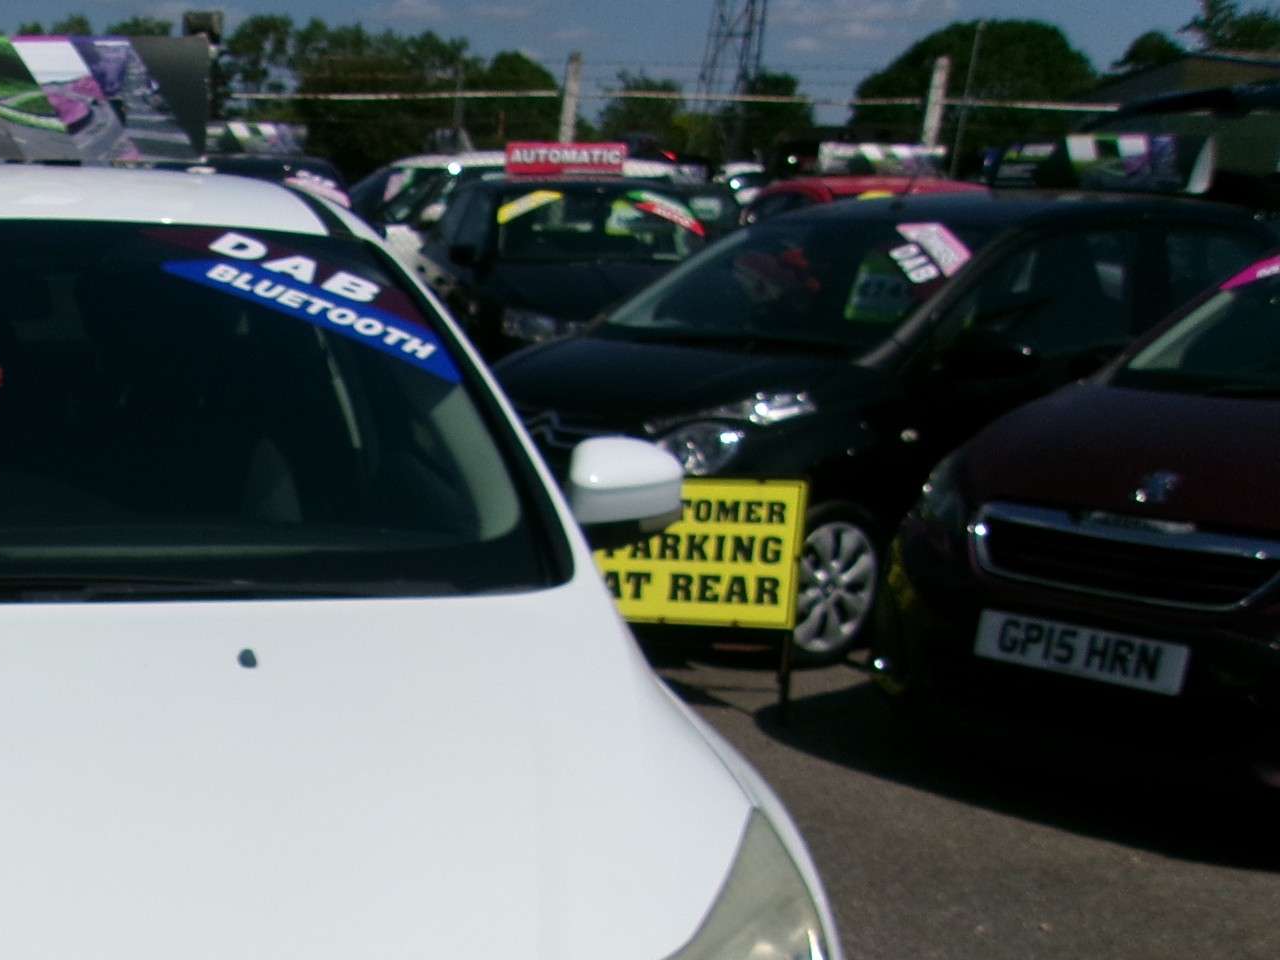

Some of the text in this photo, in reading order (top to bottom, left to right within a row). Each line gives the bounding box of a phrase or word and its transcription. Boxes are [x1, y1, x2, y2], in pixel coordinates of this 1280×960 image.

[510, 148, 621, 165] AUTOMATIC
[208, 231, 380, 302] DAB
[206, 263, 436, 361] BLUETOOTH
[604, 533, 784, 564] ARKING
[606, 570, 780, 605] AT REAR
[997, 618, 1163, 682] GP15 HRN
